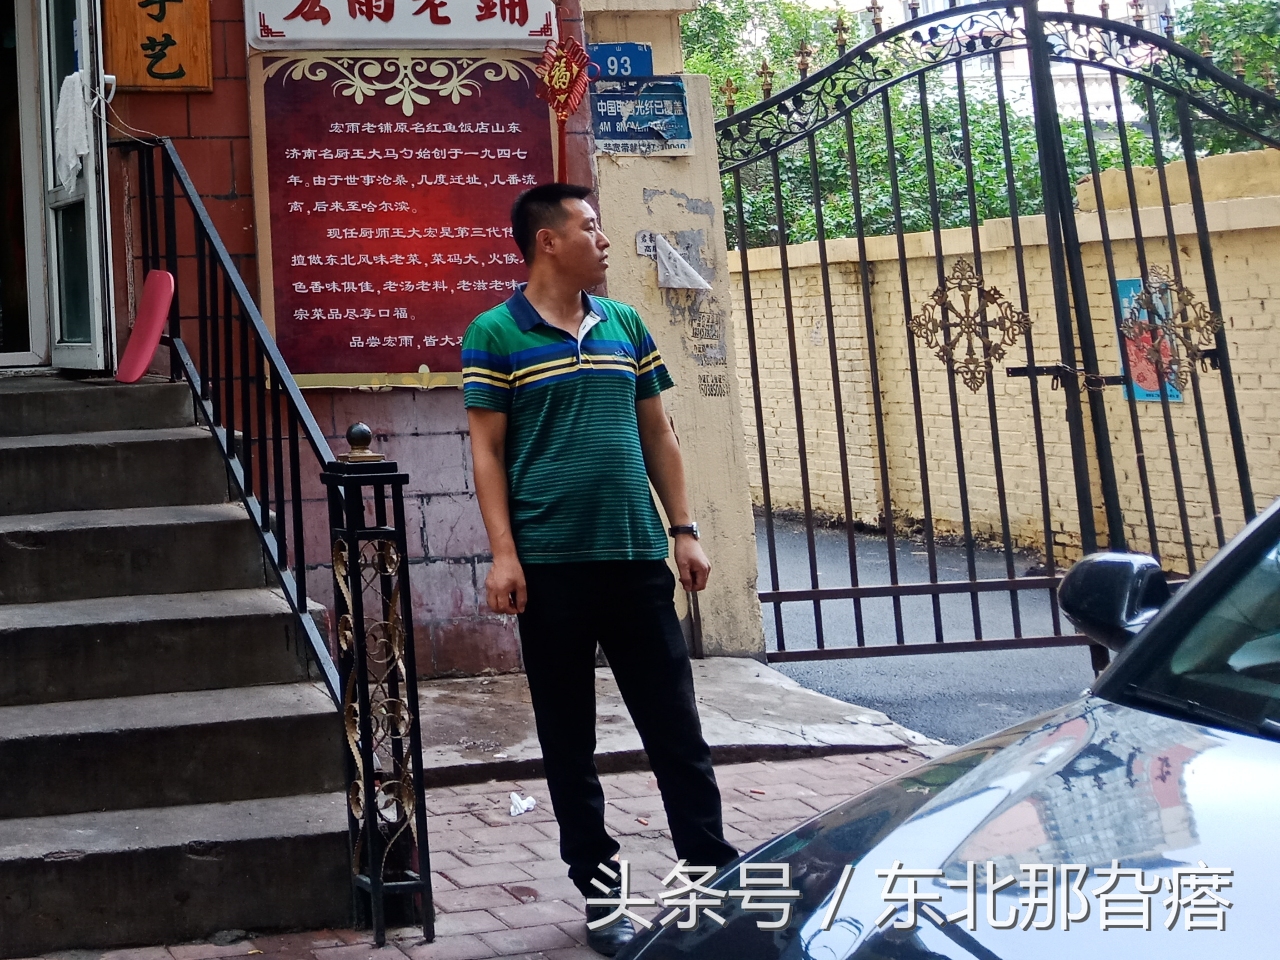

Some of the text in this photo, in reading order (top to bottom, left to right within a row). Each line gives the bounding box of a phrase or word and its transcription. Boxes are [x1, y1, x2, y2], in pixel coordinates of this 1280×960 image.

[607, 56, 631, 76] 93
[329, 122, 522, 134] 宏雨老铺原名红鱼饭店山东
[285, 148, 528, 160] 济南名厨王大马勺始创于一九四七
[291, 253, 524, 268] 擅做东北风味老菜，菜码大，火候
